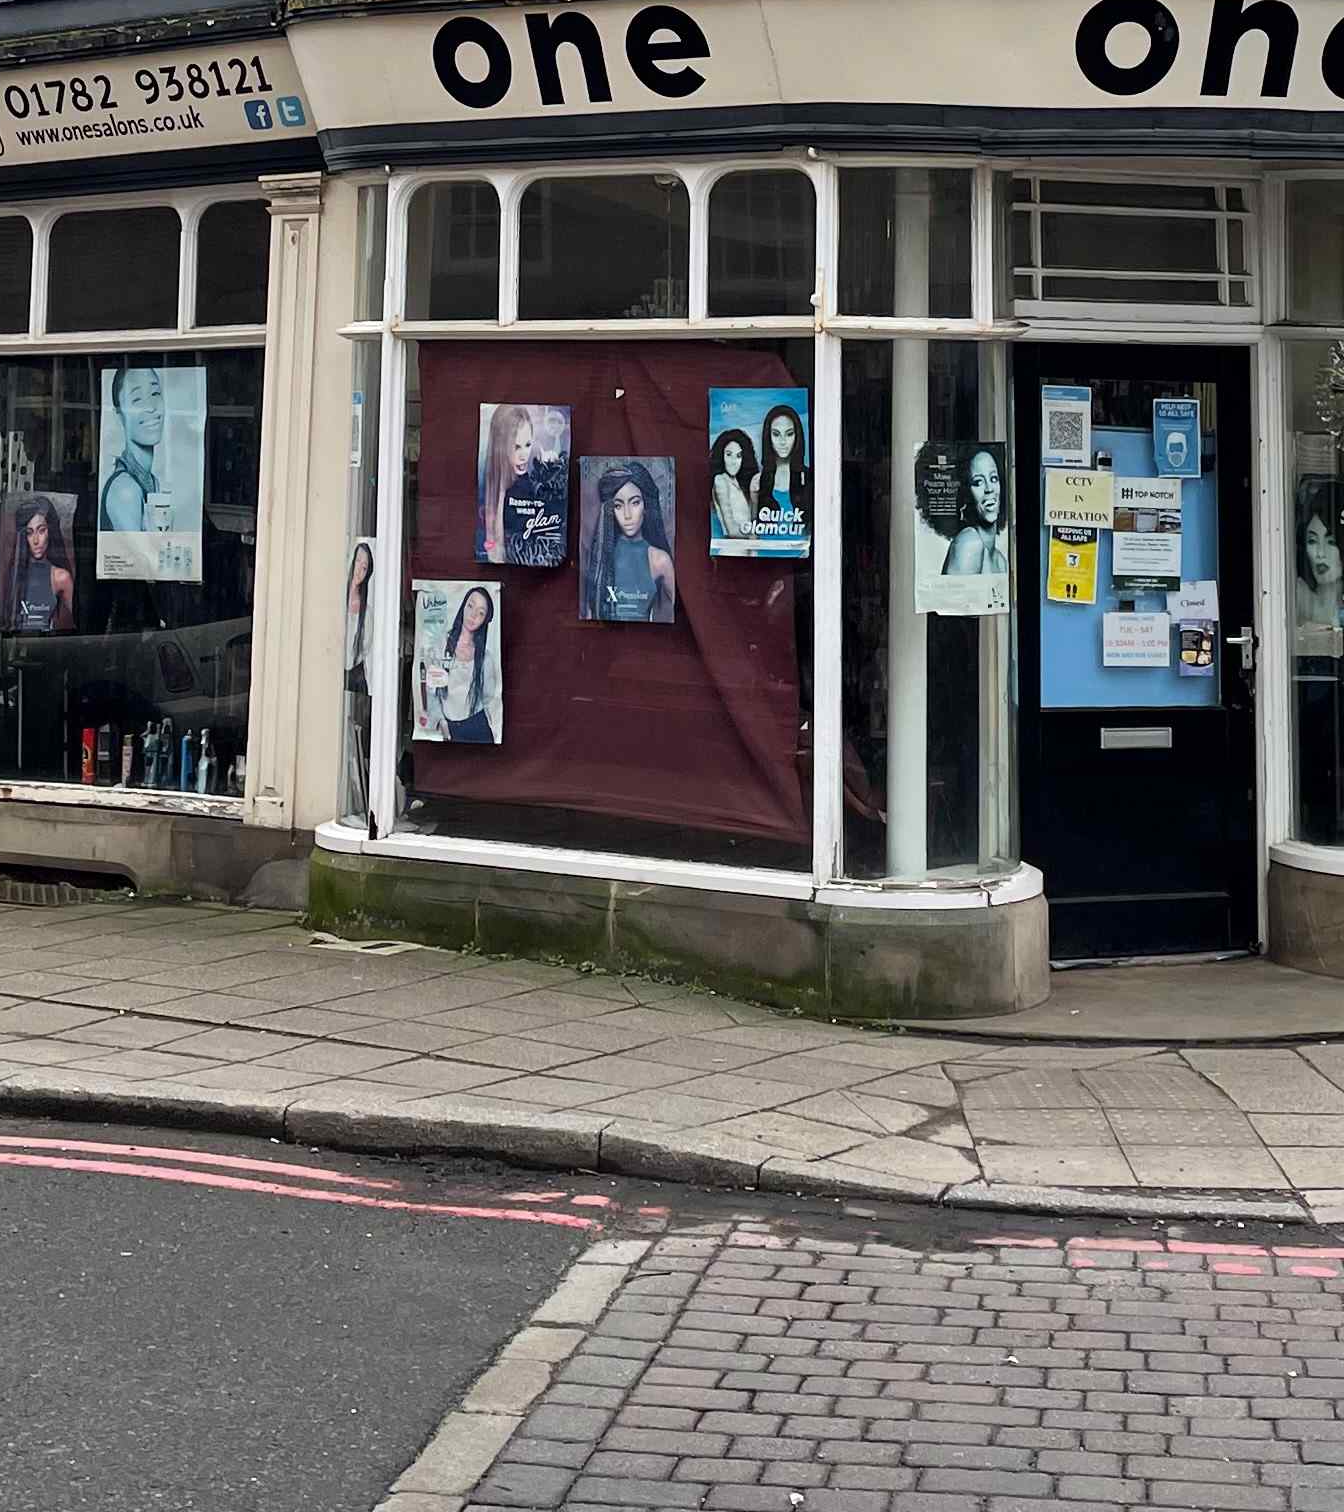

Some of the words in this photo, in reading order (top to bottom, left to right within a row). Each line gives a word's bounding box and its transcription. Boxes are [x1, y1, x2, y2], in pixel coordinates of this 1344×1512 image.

[432, 3, 712, 109] one
[4, 74, 118, 121] 01782
[135, 55, 274, 105] 938121
[15, 105, 205, 147] www.onesalons.co.uk
[1065, 476, 1094, 487] CCTV
[1074, 494, 1084, 503] IN
[1134, 490, 1149, 499] TOP
[1149, 490, 1175, 500] NOTCH
[759, 506, 805, 523] Quick
[1049, 510, 1110, 522] OPERATION
[522, 507, 561, 541] glam
[739, 520, 805, 537] Glamour
